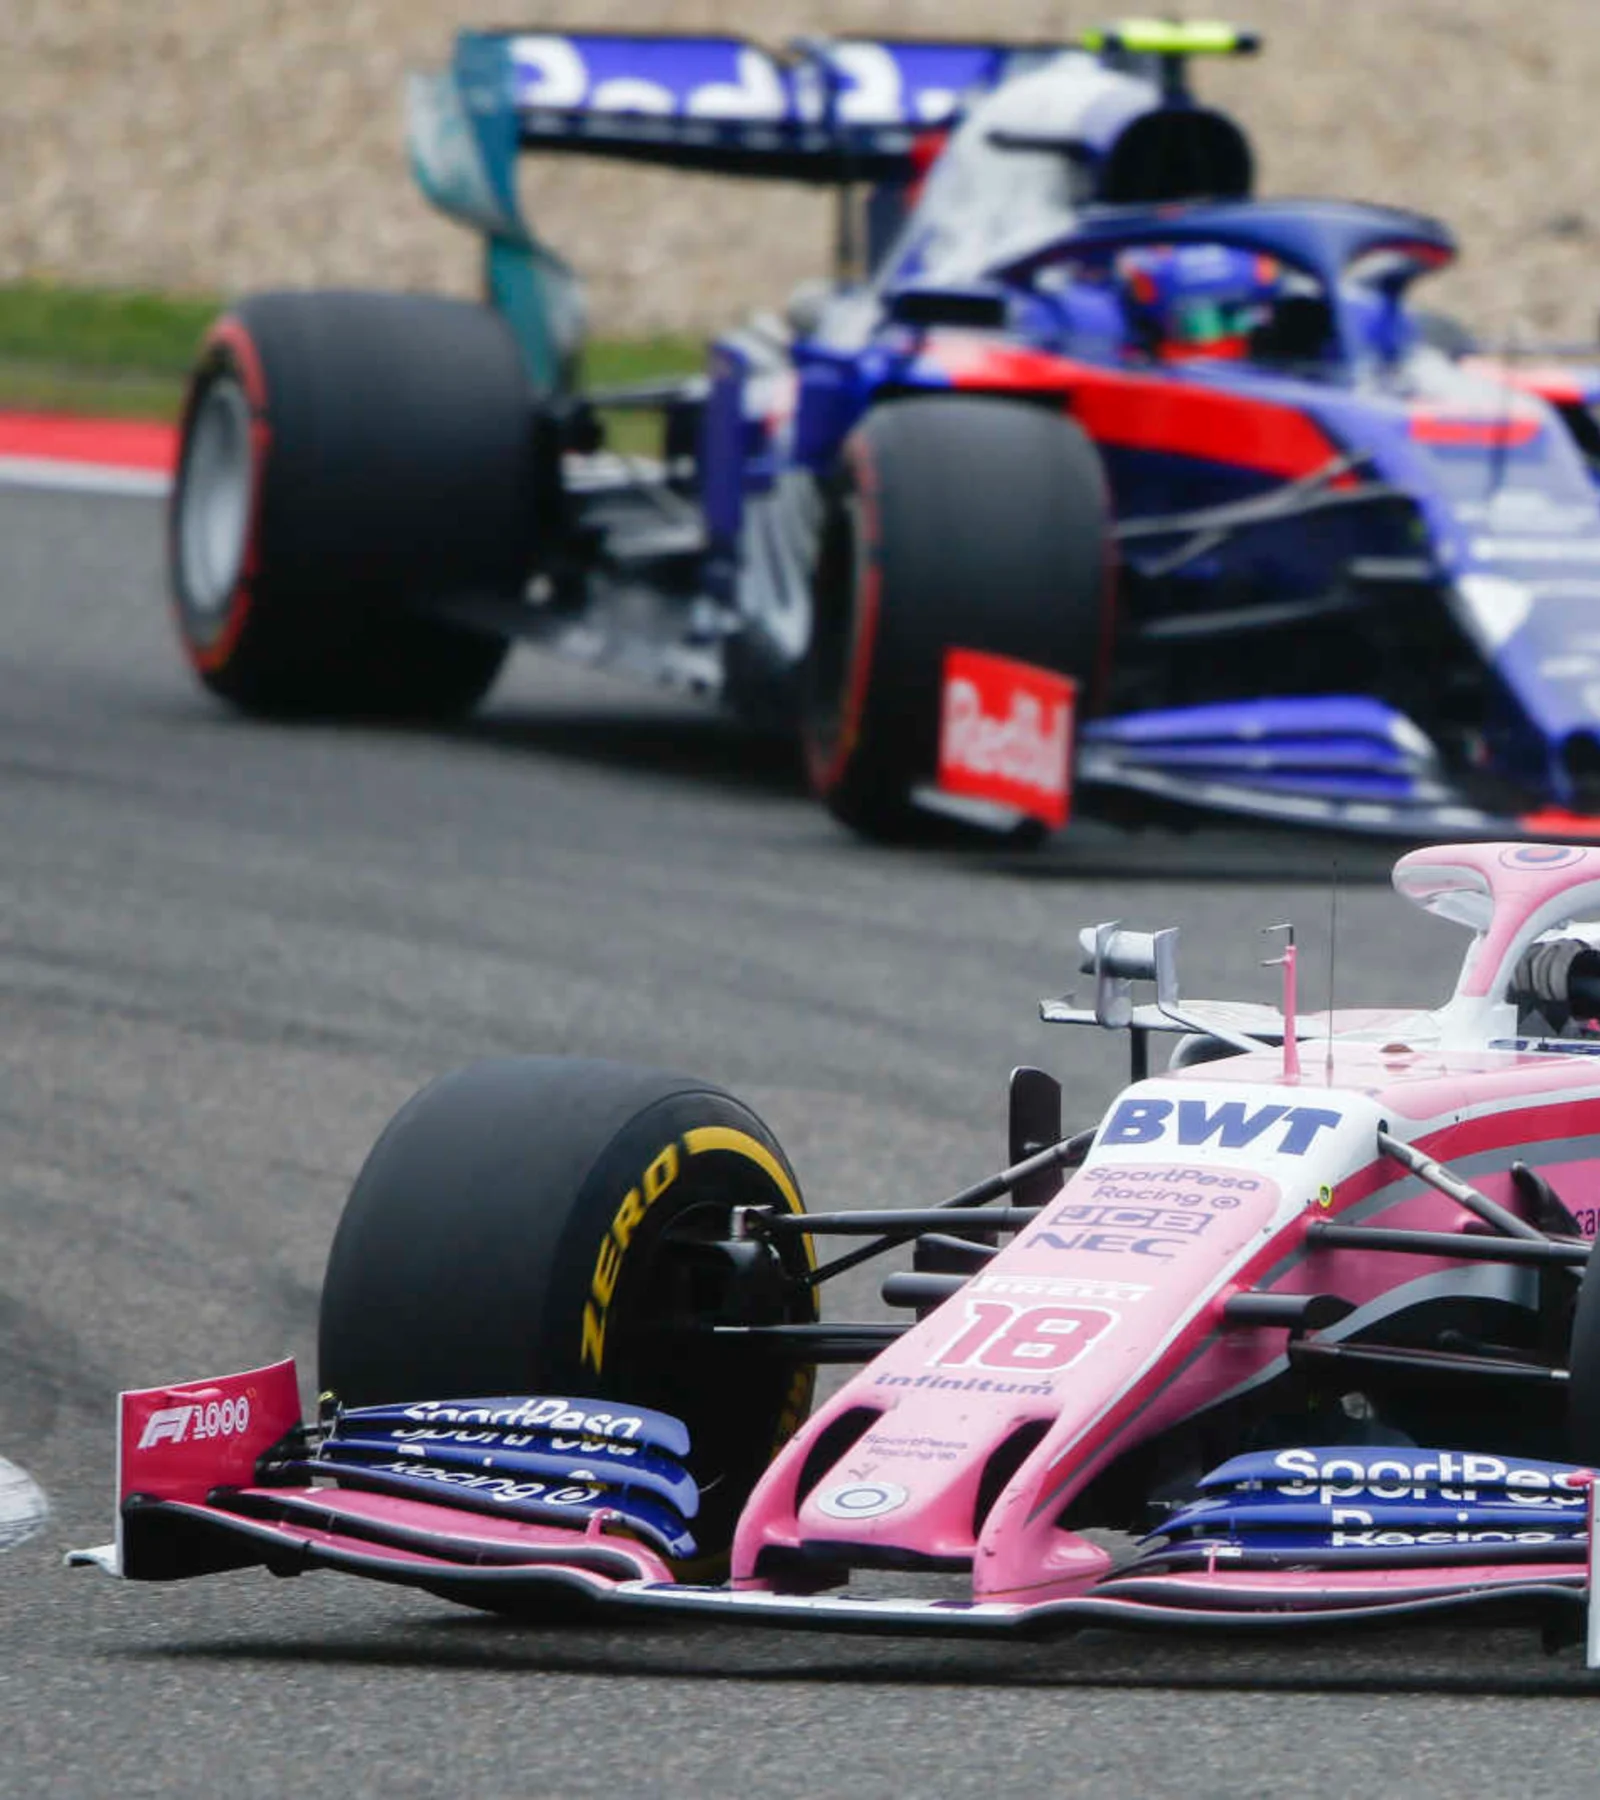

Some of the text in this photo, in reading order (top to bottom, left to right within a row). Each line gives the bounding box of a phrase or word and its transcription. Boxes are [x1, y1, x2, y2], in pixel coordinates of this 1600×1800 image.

[1099, 1099, 1342, 1155] BWT
[1083, 1167, 1261, 1192] SportPesa
[1092, 1185, 1204, 1207] Racing
[1051, 1205, 1213, 1235] JCB
[581, 1143, 681, 1375] ZERO
[1025, 1232, 1188, 1258] NEC
[925, 1298, 1121, 1373] 18
[193, 1396, 249, 1440] 1000
[1275, 1449, 1588, 1505] SportPes
